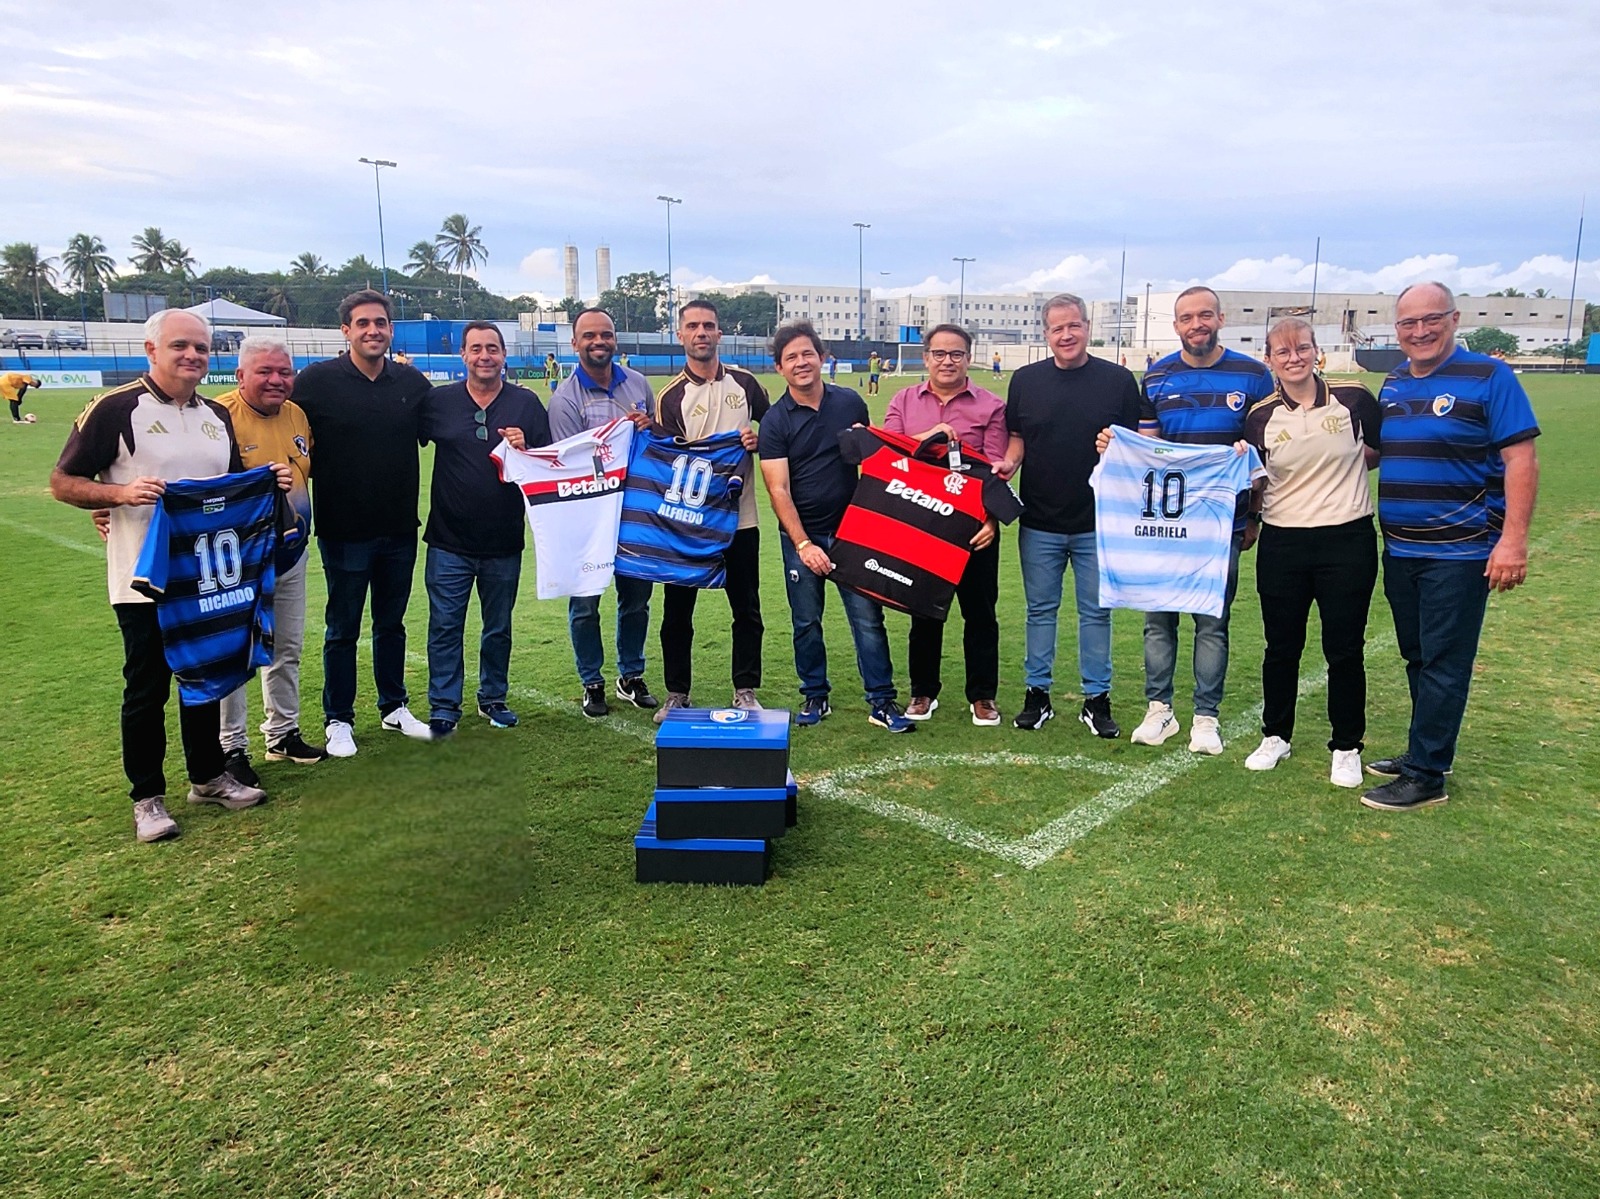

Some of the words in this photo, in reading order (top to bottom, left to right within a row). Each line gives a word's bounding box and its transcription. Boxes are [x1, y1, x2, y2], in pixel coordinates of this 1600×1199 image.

[527, 370, 545, 379] Copa
[557, 476, 620, 498] Betano
[664, 454, 713, 509] 10
[1140, 468, 1188, 522] 10
[885, 478, 955, 517] Betano
[657, 503, 704, 525] ALFREDO
[1134, 525, 1188, 539] GABRIELA
[193, 528, 243, 595] 10
[199, 586, 255, 613] RICARDO
